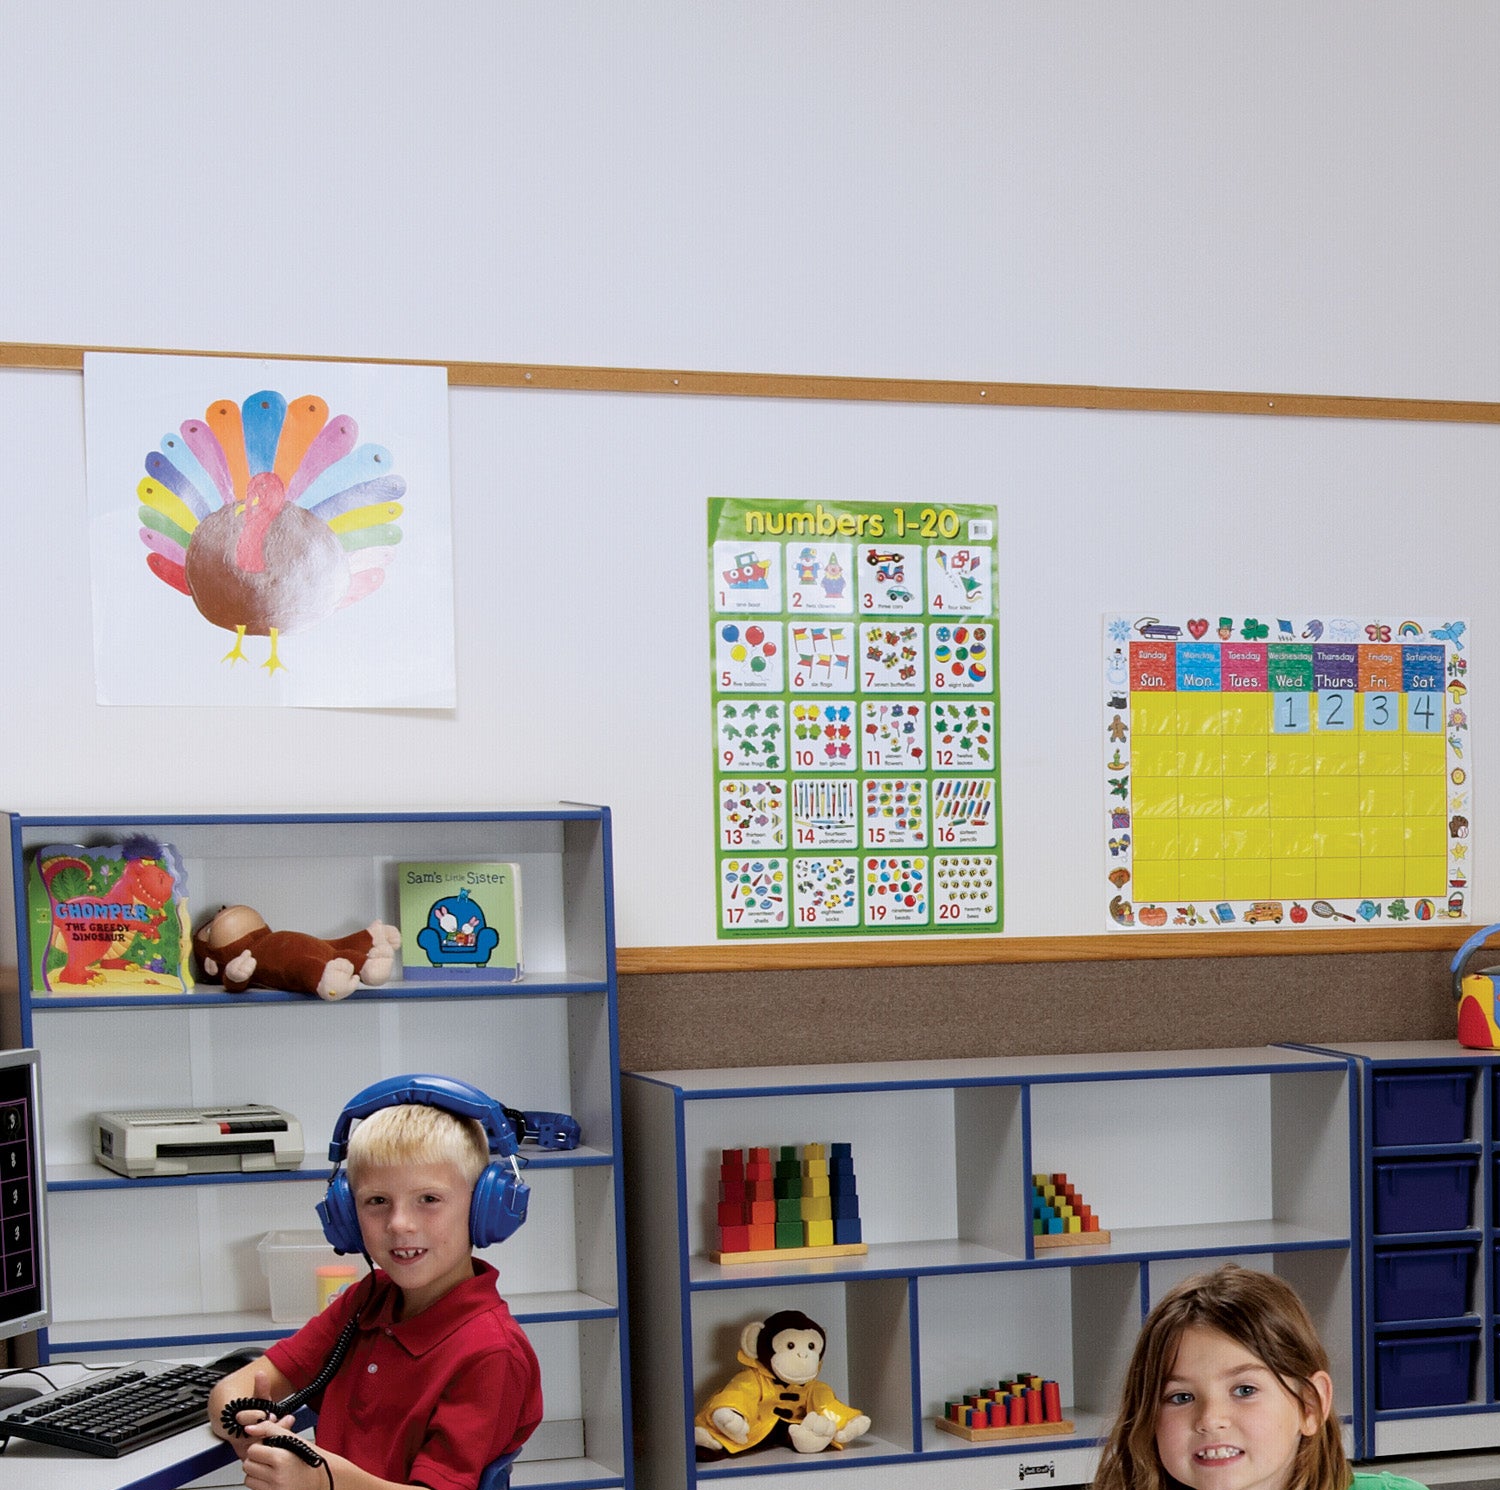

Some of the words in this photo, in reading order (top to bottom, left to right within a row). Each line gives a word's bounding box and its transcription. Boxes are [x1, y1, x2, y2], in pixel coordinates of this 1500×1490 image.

[744, 505, 885, 537] numbers
[893, 508, 961, 538] 1-20
[719, 591, 726, 607] 1
[792, 592, 803, 608] 2
[863, 593, 874, 609] 3
[933, 594, 944, 610] 4
[1138, 651, 1167, 661] Sunday
[1183, 651, 1215, 661] Monday
[1228, 651, 1261, 662] Tuesday
[1268, 652, 1313, 663] Wednesday
[1317, 651, 1355, 662] Thursday
[1367, 652, 1393, 663] Friday
[1405, 652, 1442, 663] Saturday
[721, 672, 732, 688] 5
[794, 671, 804, 687] 6
[865, 672, 875, 688] 7
[935, 672, 945, 688] 8
[1140, 673, 1166, 687] Sun.
[1183, 673, 1215, 687] Mon.
[1228, 673, 1262, 687] Tues.
[1275, 675, 1306, 688] Wed.
[1315, 674, 1357, 688] Thurs.
[1370, 675, 1391, 688] Fri.
[1412, 675, 1436, 688] Sat.
[1284, 696, 1297, 728] 1
[1326, 693, 1345, 726] 2
[1372, 695, 1389, 726] 3
[1413, 694, 1435, 730] 4
[723, 751, 734, 766] 9
[795, 750, 814, 766] 10
[867, 750, 881, 765] 11
[936, 750, 953, 765] 12
[724, 829, 743, 845] 13
[797, 829, 815, 843] 14
[868, 828, 885, 843] 15
[937, 827, 955, 842] 16
[406, 871, 443, 885] Sam's
[466, 871, 506, 885] Sister
[55, 902, 150, 922] CHOMPER
[726, 908, 744, 924] 17
[798, 907, 817, 922] 18
[869, 906, 886, 921] 19
[939, 904, 960, 919] 20
[64, 922, 87, 932] THE
[89, 922, 131, 933] GREEDY
[72, 931, 127, 943] DINOSAUR
